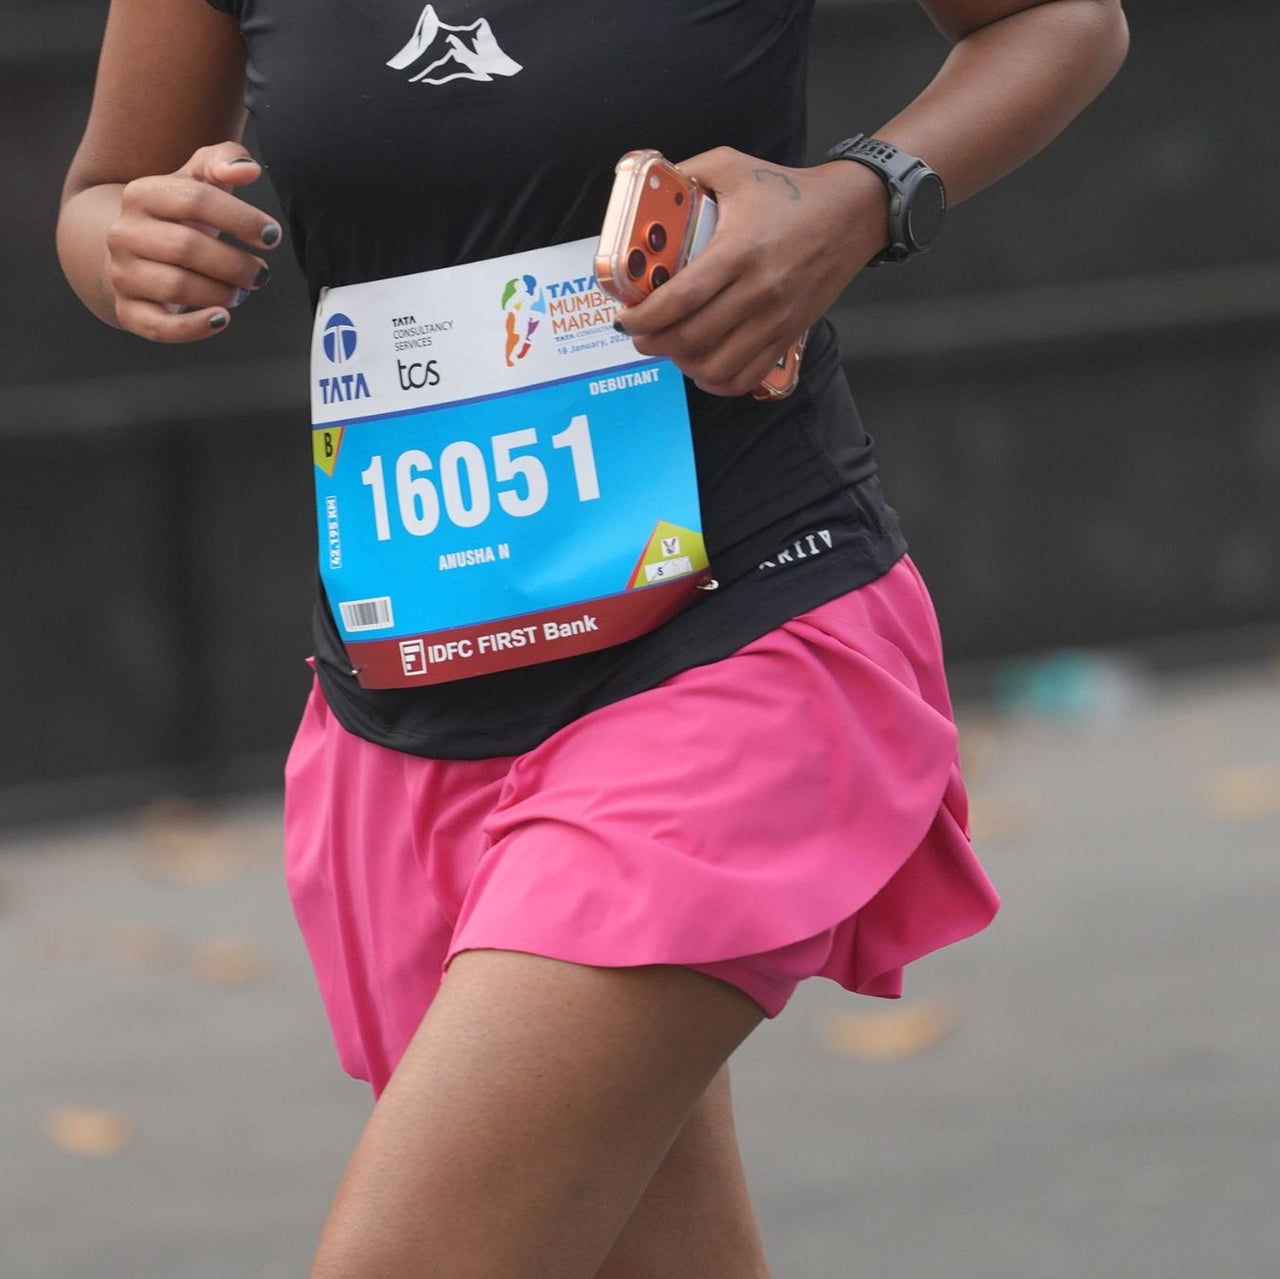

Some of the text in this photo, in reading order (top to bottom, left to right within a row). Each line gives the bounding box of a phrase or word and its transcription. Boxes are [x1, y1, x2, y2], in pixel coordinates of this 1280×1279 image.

[391, 316, 416, 328] TATA
[392, 320, 454, 340] CONSULTANCY
[394, 337, 433, 351] SERVICES
[318, 372, 371, 405] TATA
[397, 359, 440, 391] tcs
[588, 368, 660, 396] DEBUTANT
[323, 432, 334, 458] B
[361, 414, 601, 541] 16051
[438, 543, 510, 570] ANUSHA N
[428, 615, 599, 664] IDFC FIRST Bank
